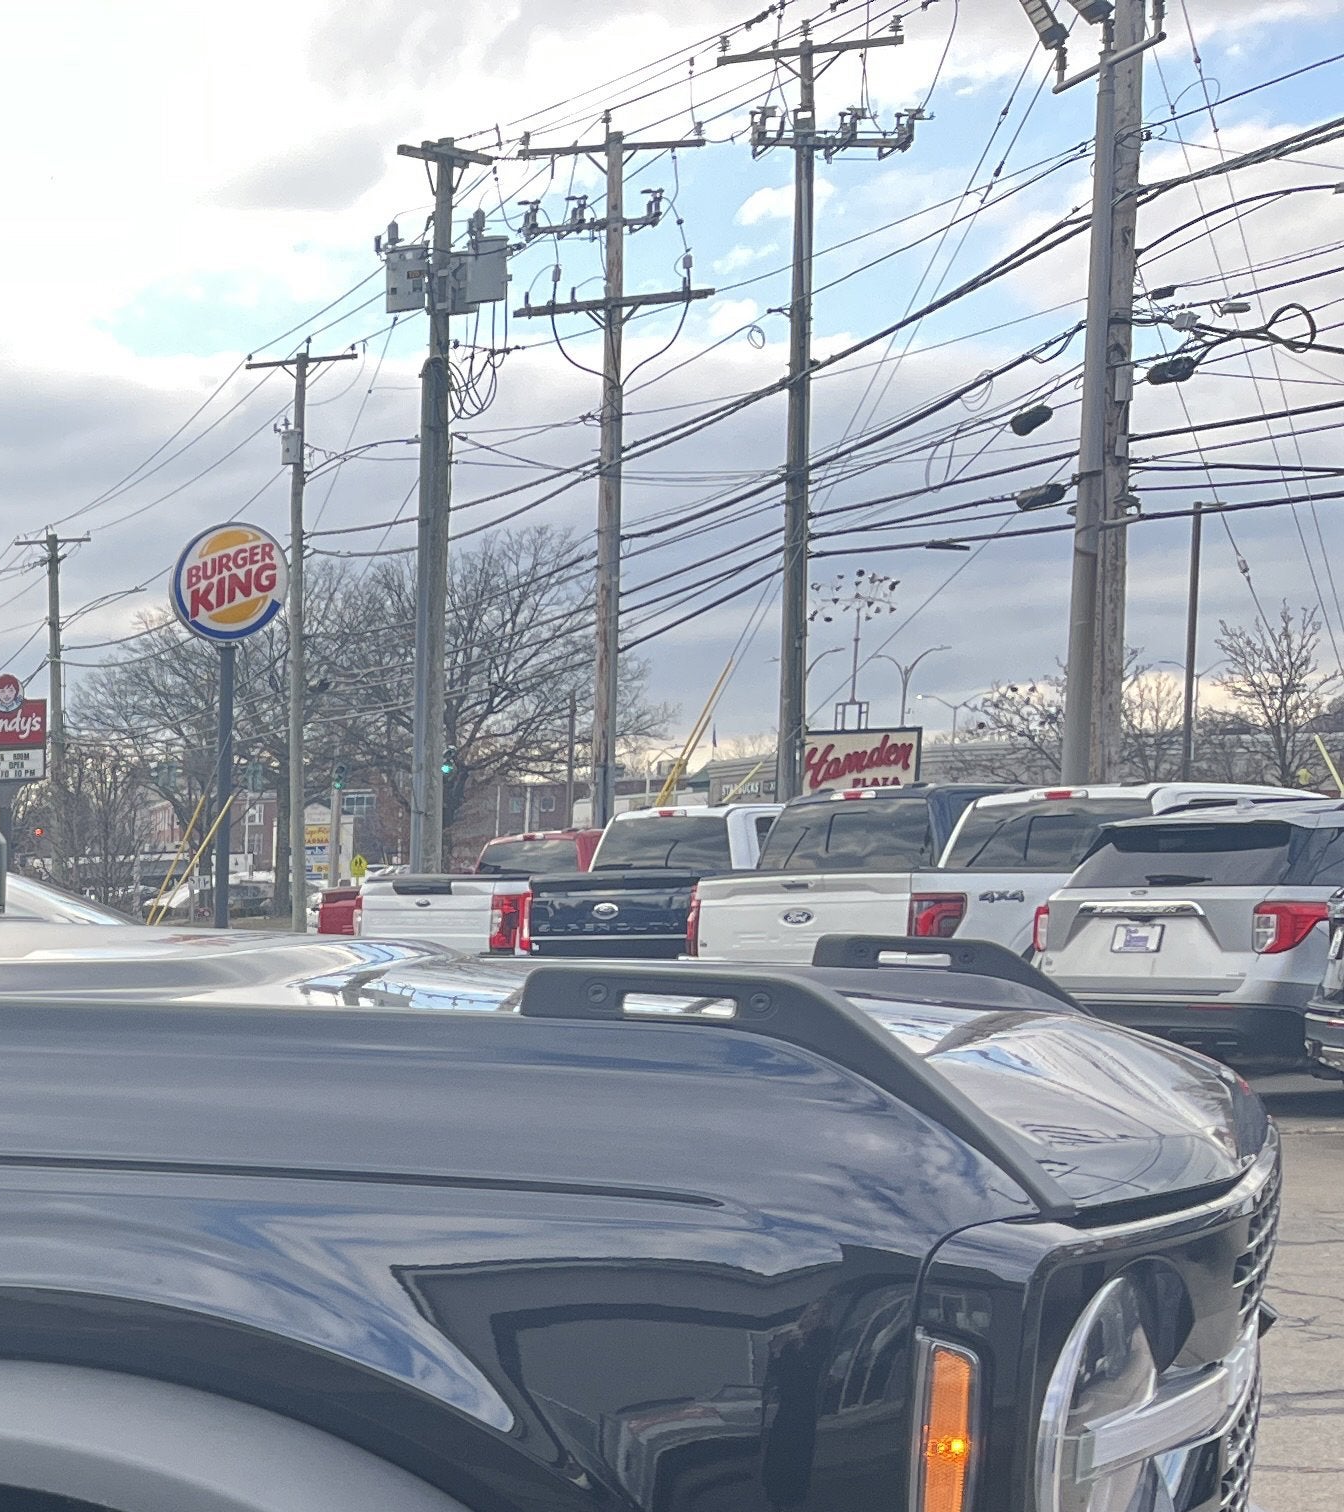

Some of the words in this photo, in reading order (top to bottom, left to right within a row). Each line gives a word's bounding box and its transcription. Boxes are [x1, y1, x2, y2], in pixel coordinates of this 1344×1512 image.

[186, 542, 275, 589] BURGER
[190, 563, 277, 620] KING
[805, 734, 913, 788] Hamden
[852, 777, 901, 788] PLAZA
